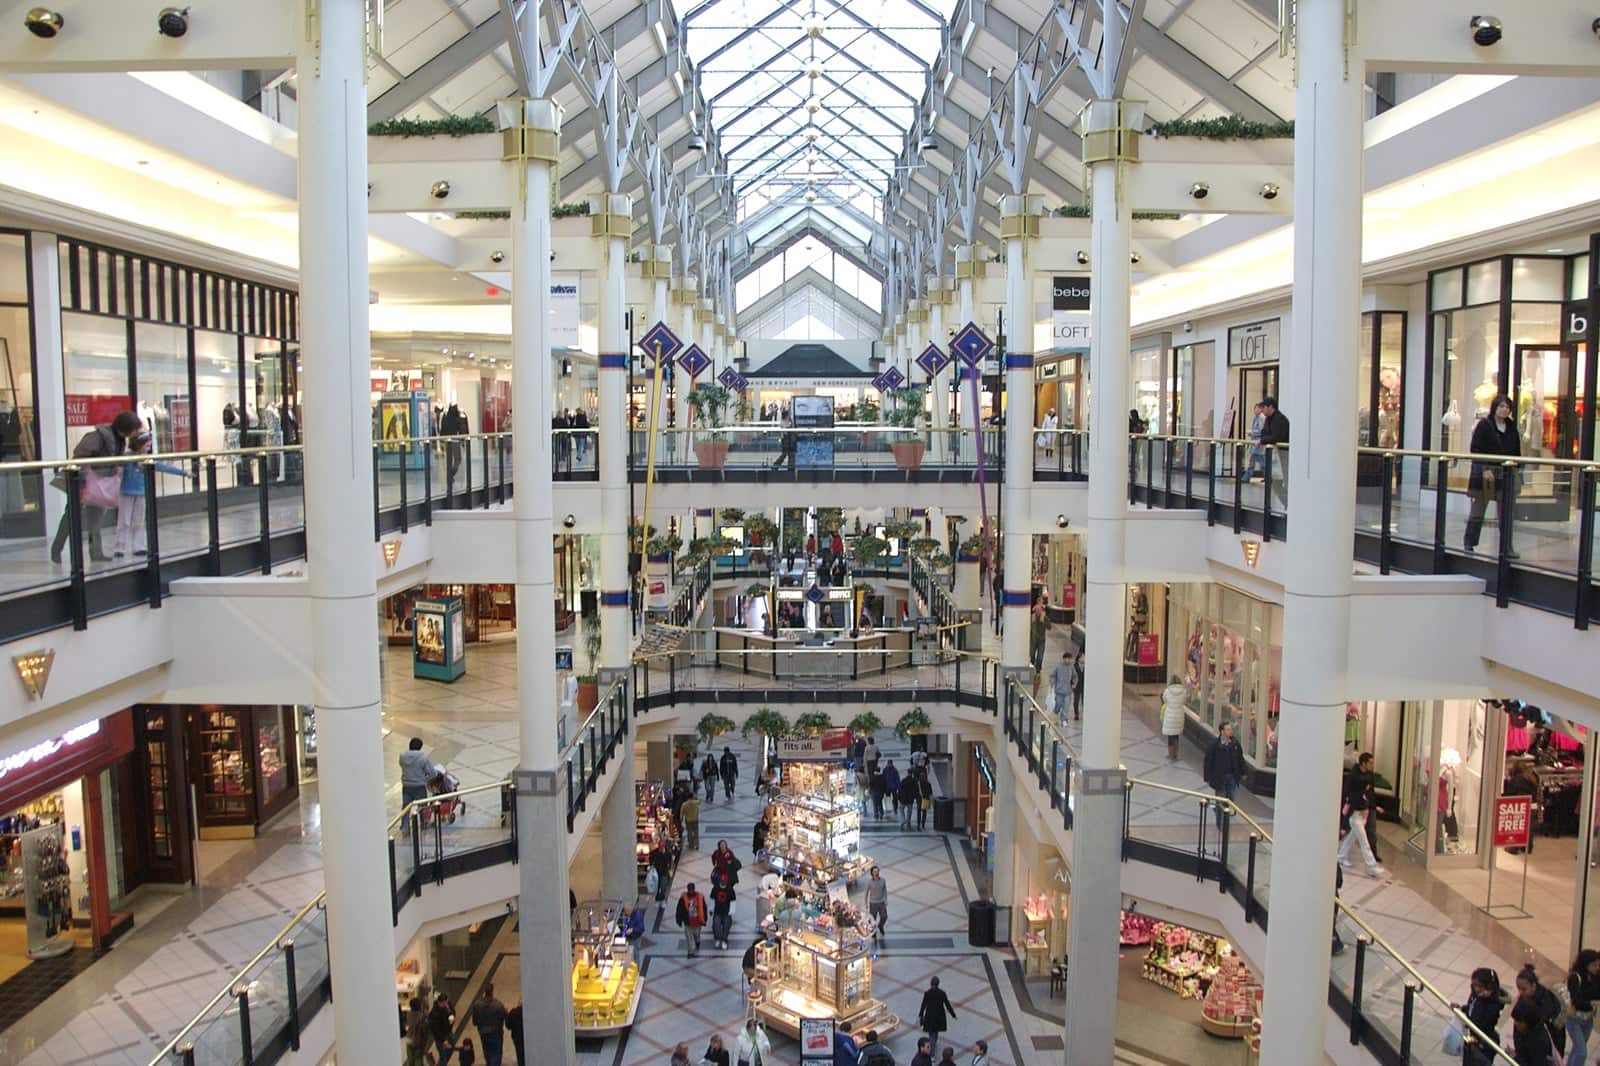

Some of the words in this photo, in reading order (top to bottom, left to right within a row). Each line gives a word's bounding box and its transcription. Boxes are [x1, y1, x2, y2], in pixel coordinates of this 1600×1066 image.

[1053, 287, 1090, 297] bebe
[1570, 312, 1587, 334] b
[1053, 326, 1090, 338] LOFT
[1240, 334, 1268, 362] LOFT
[66, 402, 89, 414] SALE
[784, 742, 799, 751] fits
[1498, 802, 1527, 815] SALE
[1498, 819, 1526, 832] FREE
